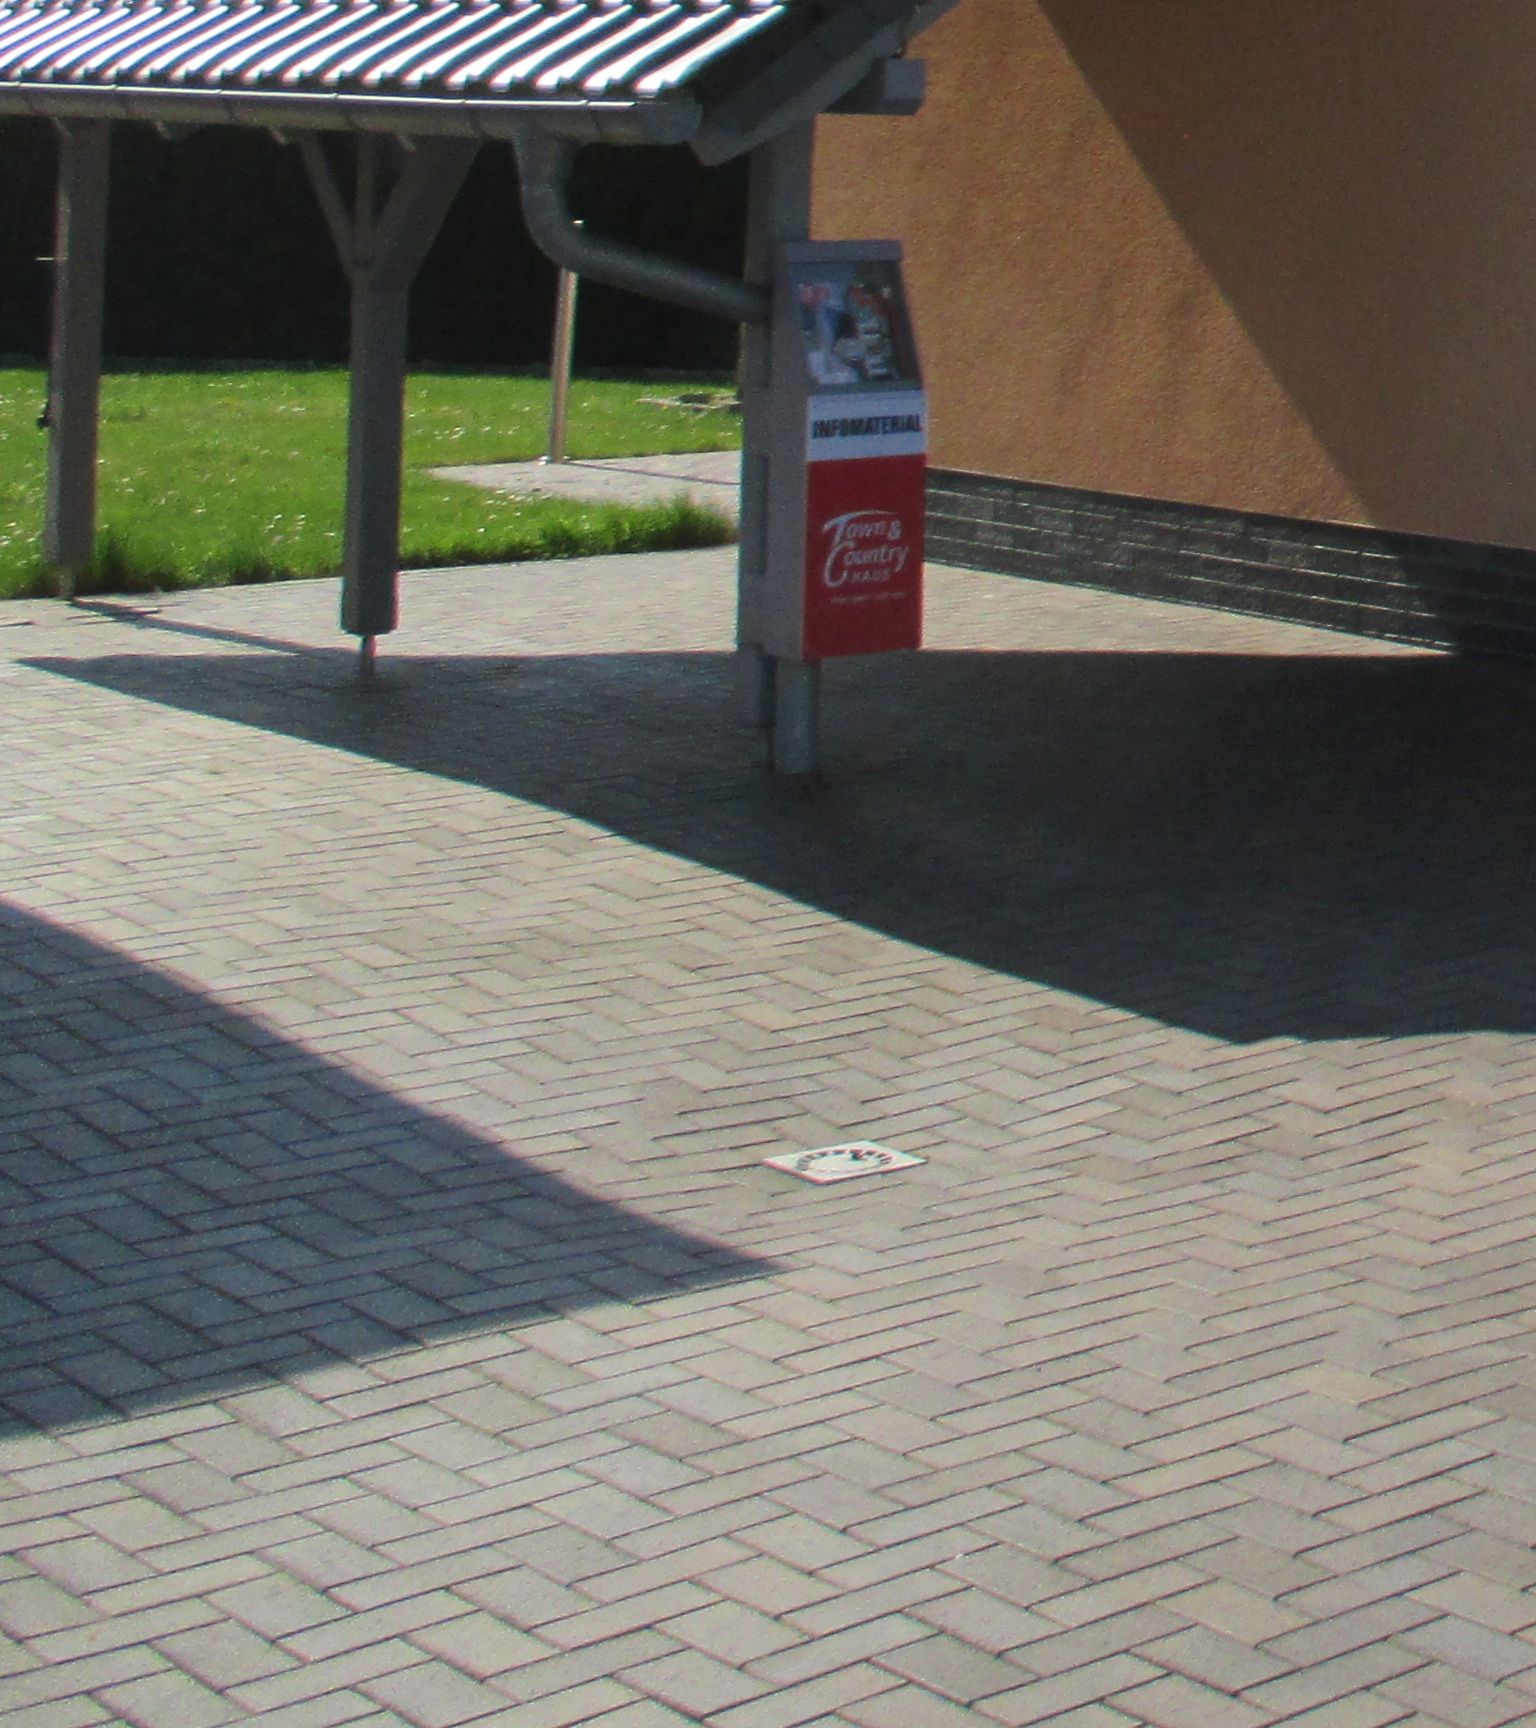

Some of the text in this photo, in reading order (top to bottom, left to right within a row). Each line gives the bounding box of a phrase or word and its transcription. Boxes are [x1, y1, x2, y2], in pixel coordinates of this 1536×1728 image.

[813, 414, 922, 438] INFOMATERIAL
[822, 509, 902, 546] Town &
[824, 540, 910, 587] Country
